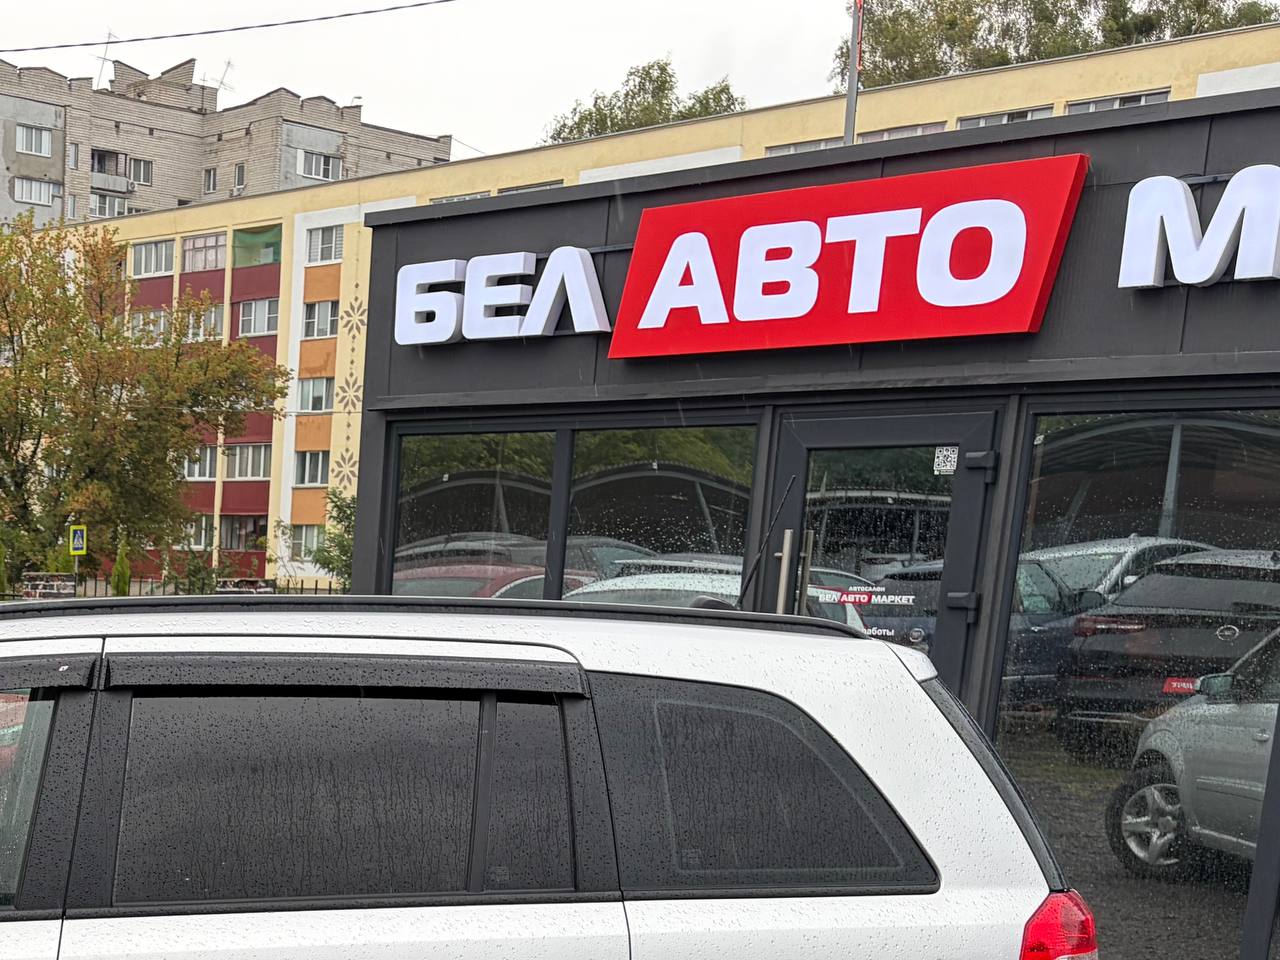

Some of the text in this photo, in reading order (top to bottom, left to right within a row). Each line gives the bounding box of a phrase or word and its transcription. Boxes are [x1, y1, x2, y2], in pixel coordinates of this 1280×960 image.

[394, 246, 612, 346] БЕЛ
[637, 199, 1027, 329] АВТО
[818, 594, 915, 605] БЕЛ АВТО МАРКЕТ
